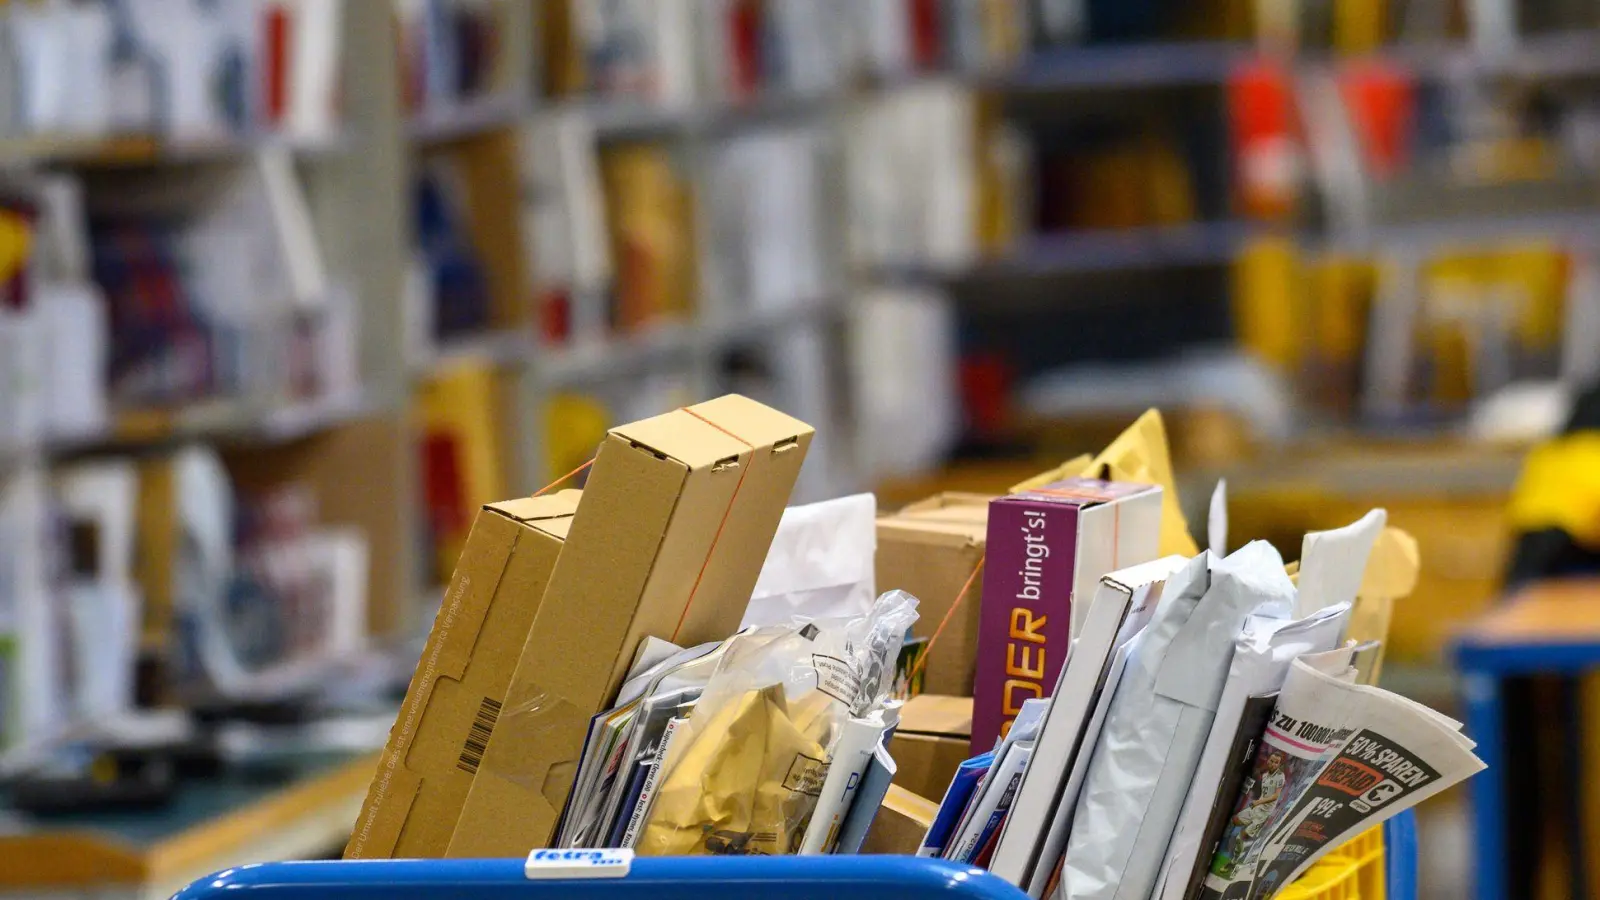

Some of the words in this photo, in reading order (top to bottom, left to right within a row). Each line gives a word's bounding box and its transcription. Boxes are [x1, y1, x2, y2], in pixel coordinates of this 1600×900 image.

[1001, 607, 1047, 740] DER
[351, 844, 363, 860] Der
[360, 805, 378, 842] Umwelt
[374, 771, 392, 806] zuliebe:
[387, 749, 400, 769] Dies
[397, 736, 406, 748] ist
[402, 715, 413, 735] eine
[410, 631, 448, 714] volumenoptimierte
[443, 576, 470, 630] Verpackung
[1275, 714, 1297, 733] zu
[657, 730, 673, 763] Supercheck:
[650, 762, 660, 781] Clever
[1324, 760, 1377, 791] PREPAID
[1370, 749, 1430, 788] SPAREN
[643, 780, 653, 792] 600
[636, 800, 646, 813] Test:
[535, 850, 603, 860] fetra
